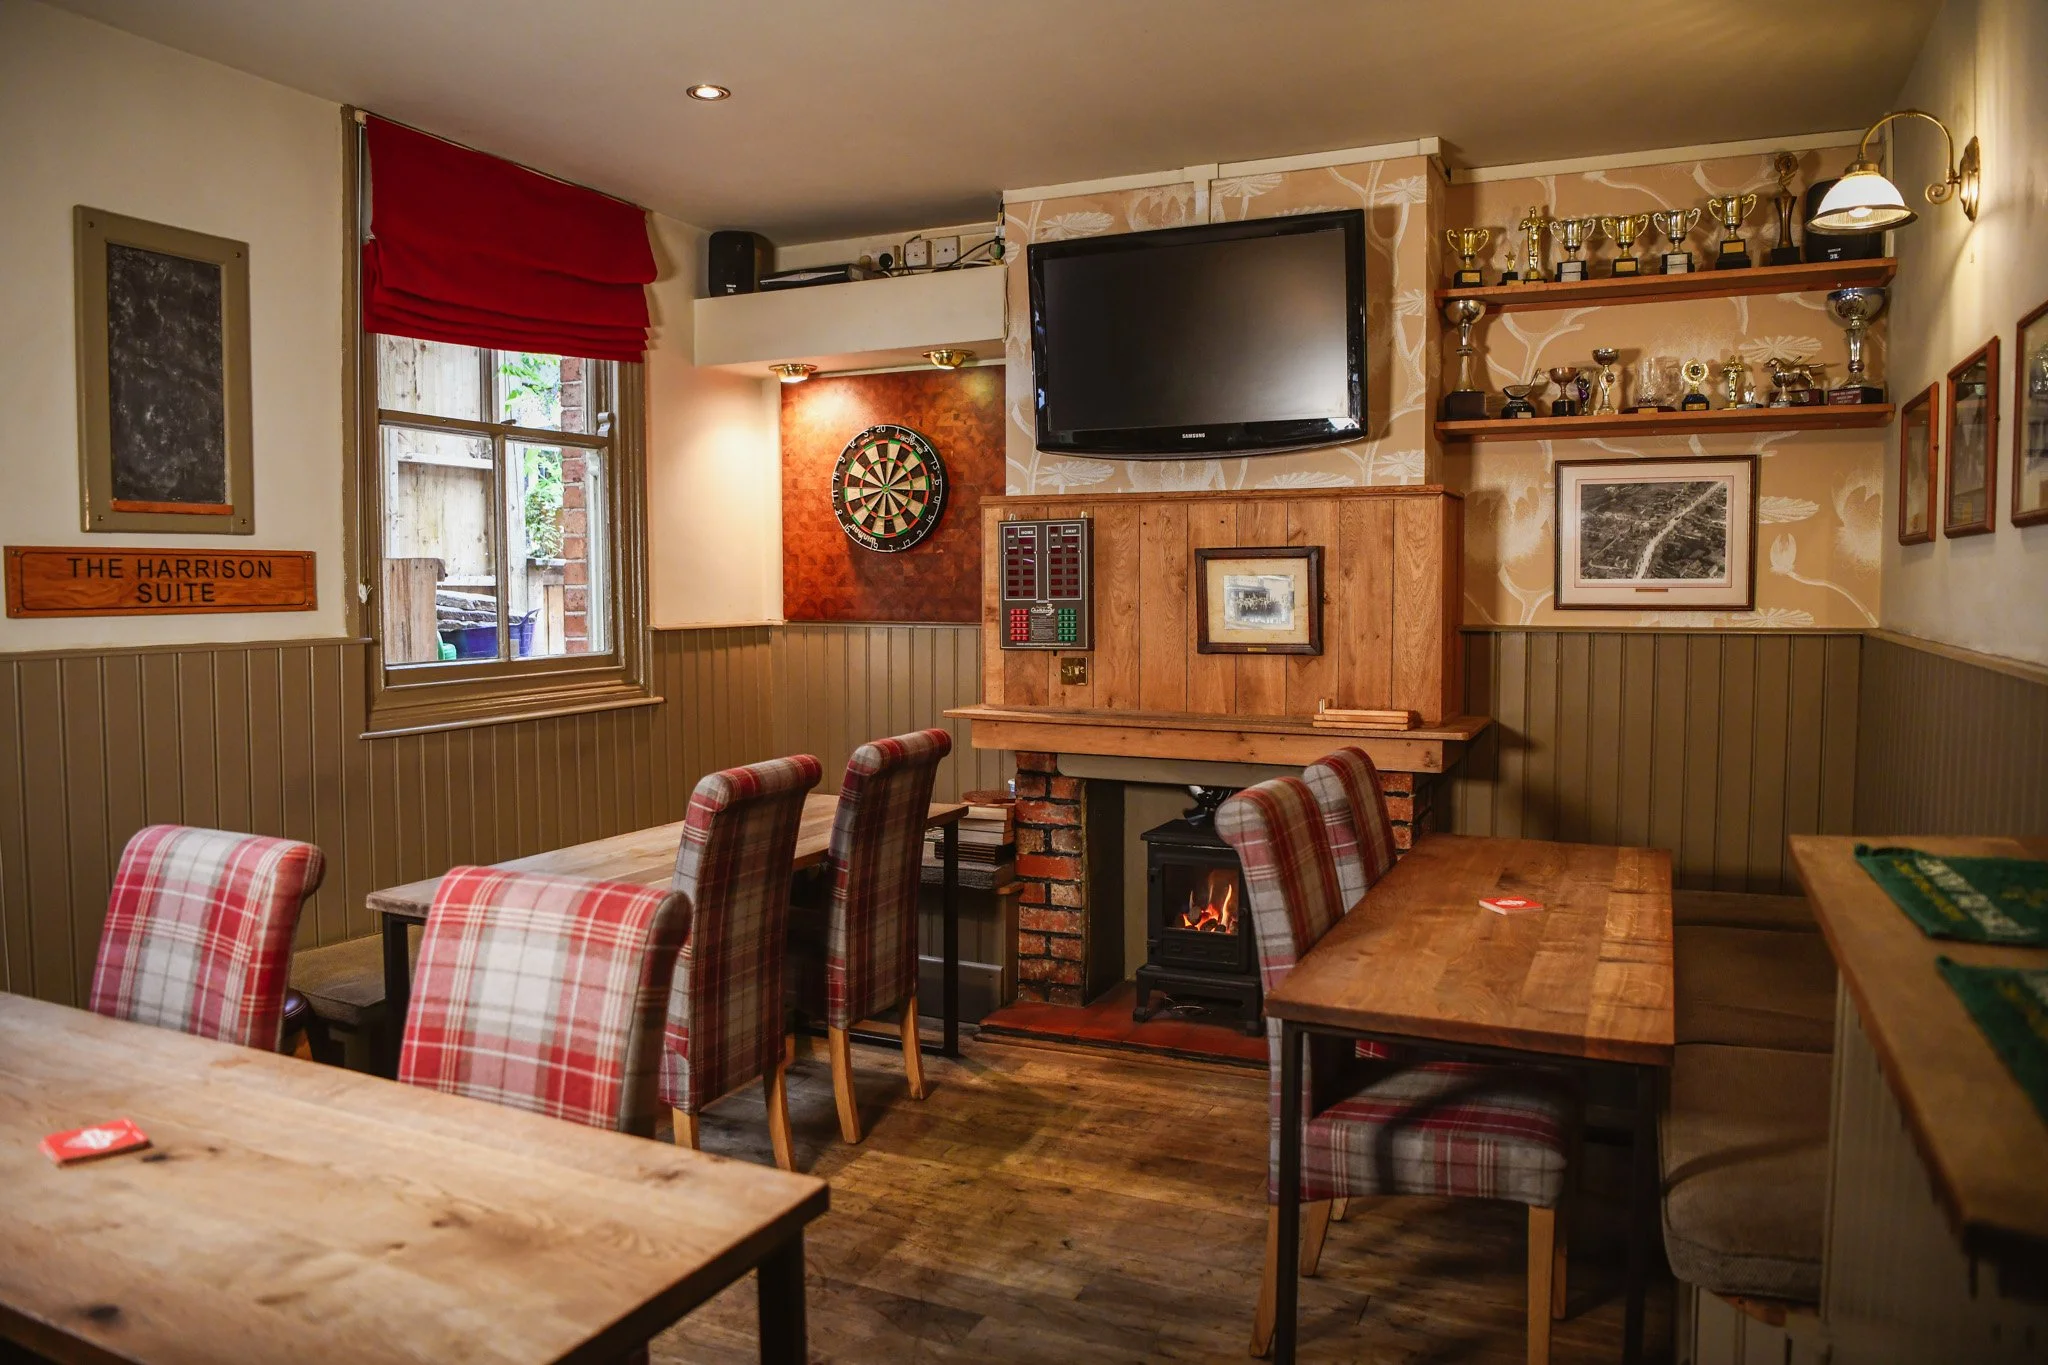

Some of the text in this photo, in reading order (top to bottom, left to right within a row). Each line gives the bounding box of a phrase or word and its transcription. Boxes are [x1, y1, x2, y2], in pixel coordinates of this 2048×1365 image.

[67, 558, 272, 578] THE HARRISON
[136, 583, 216, 603] SUITE
